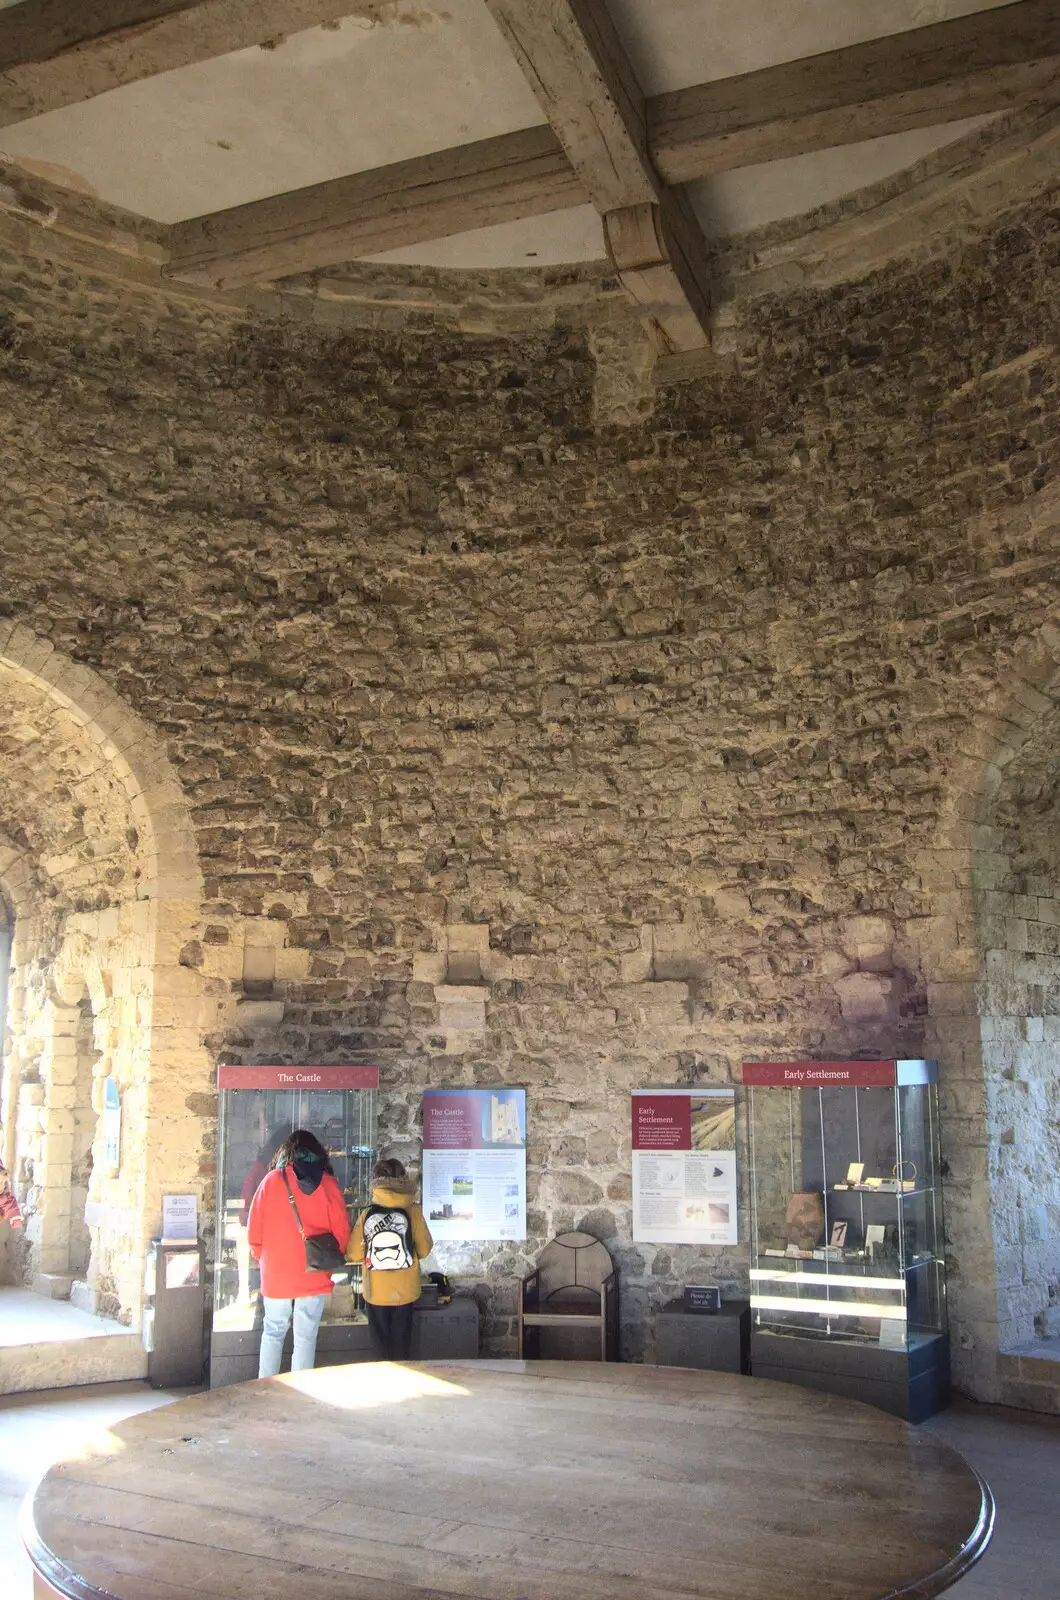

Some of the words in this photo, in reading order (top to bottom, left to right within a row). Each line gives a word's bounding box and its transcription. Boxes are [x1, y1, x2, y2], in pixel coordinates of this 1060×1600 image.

[278, 1073, 294, 1082] The
[295, 1073, 321, 1082] Castle
[784, 1070, 805, 1080] Early
[806, 1070, 850, 1079] Settlement
[430, 1108, 443, 1116] The
[443, 1108, 464, 1116] Castle
[638, 1107, 656, 1116] Early
